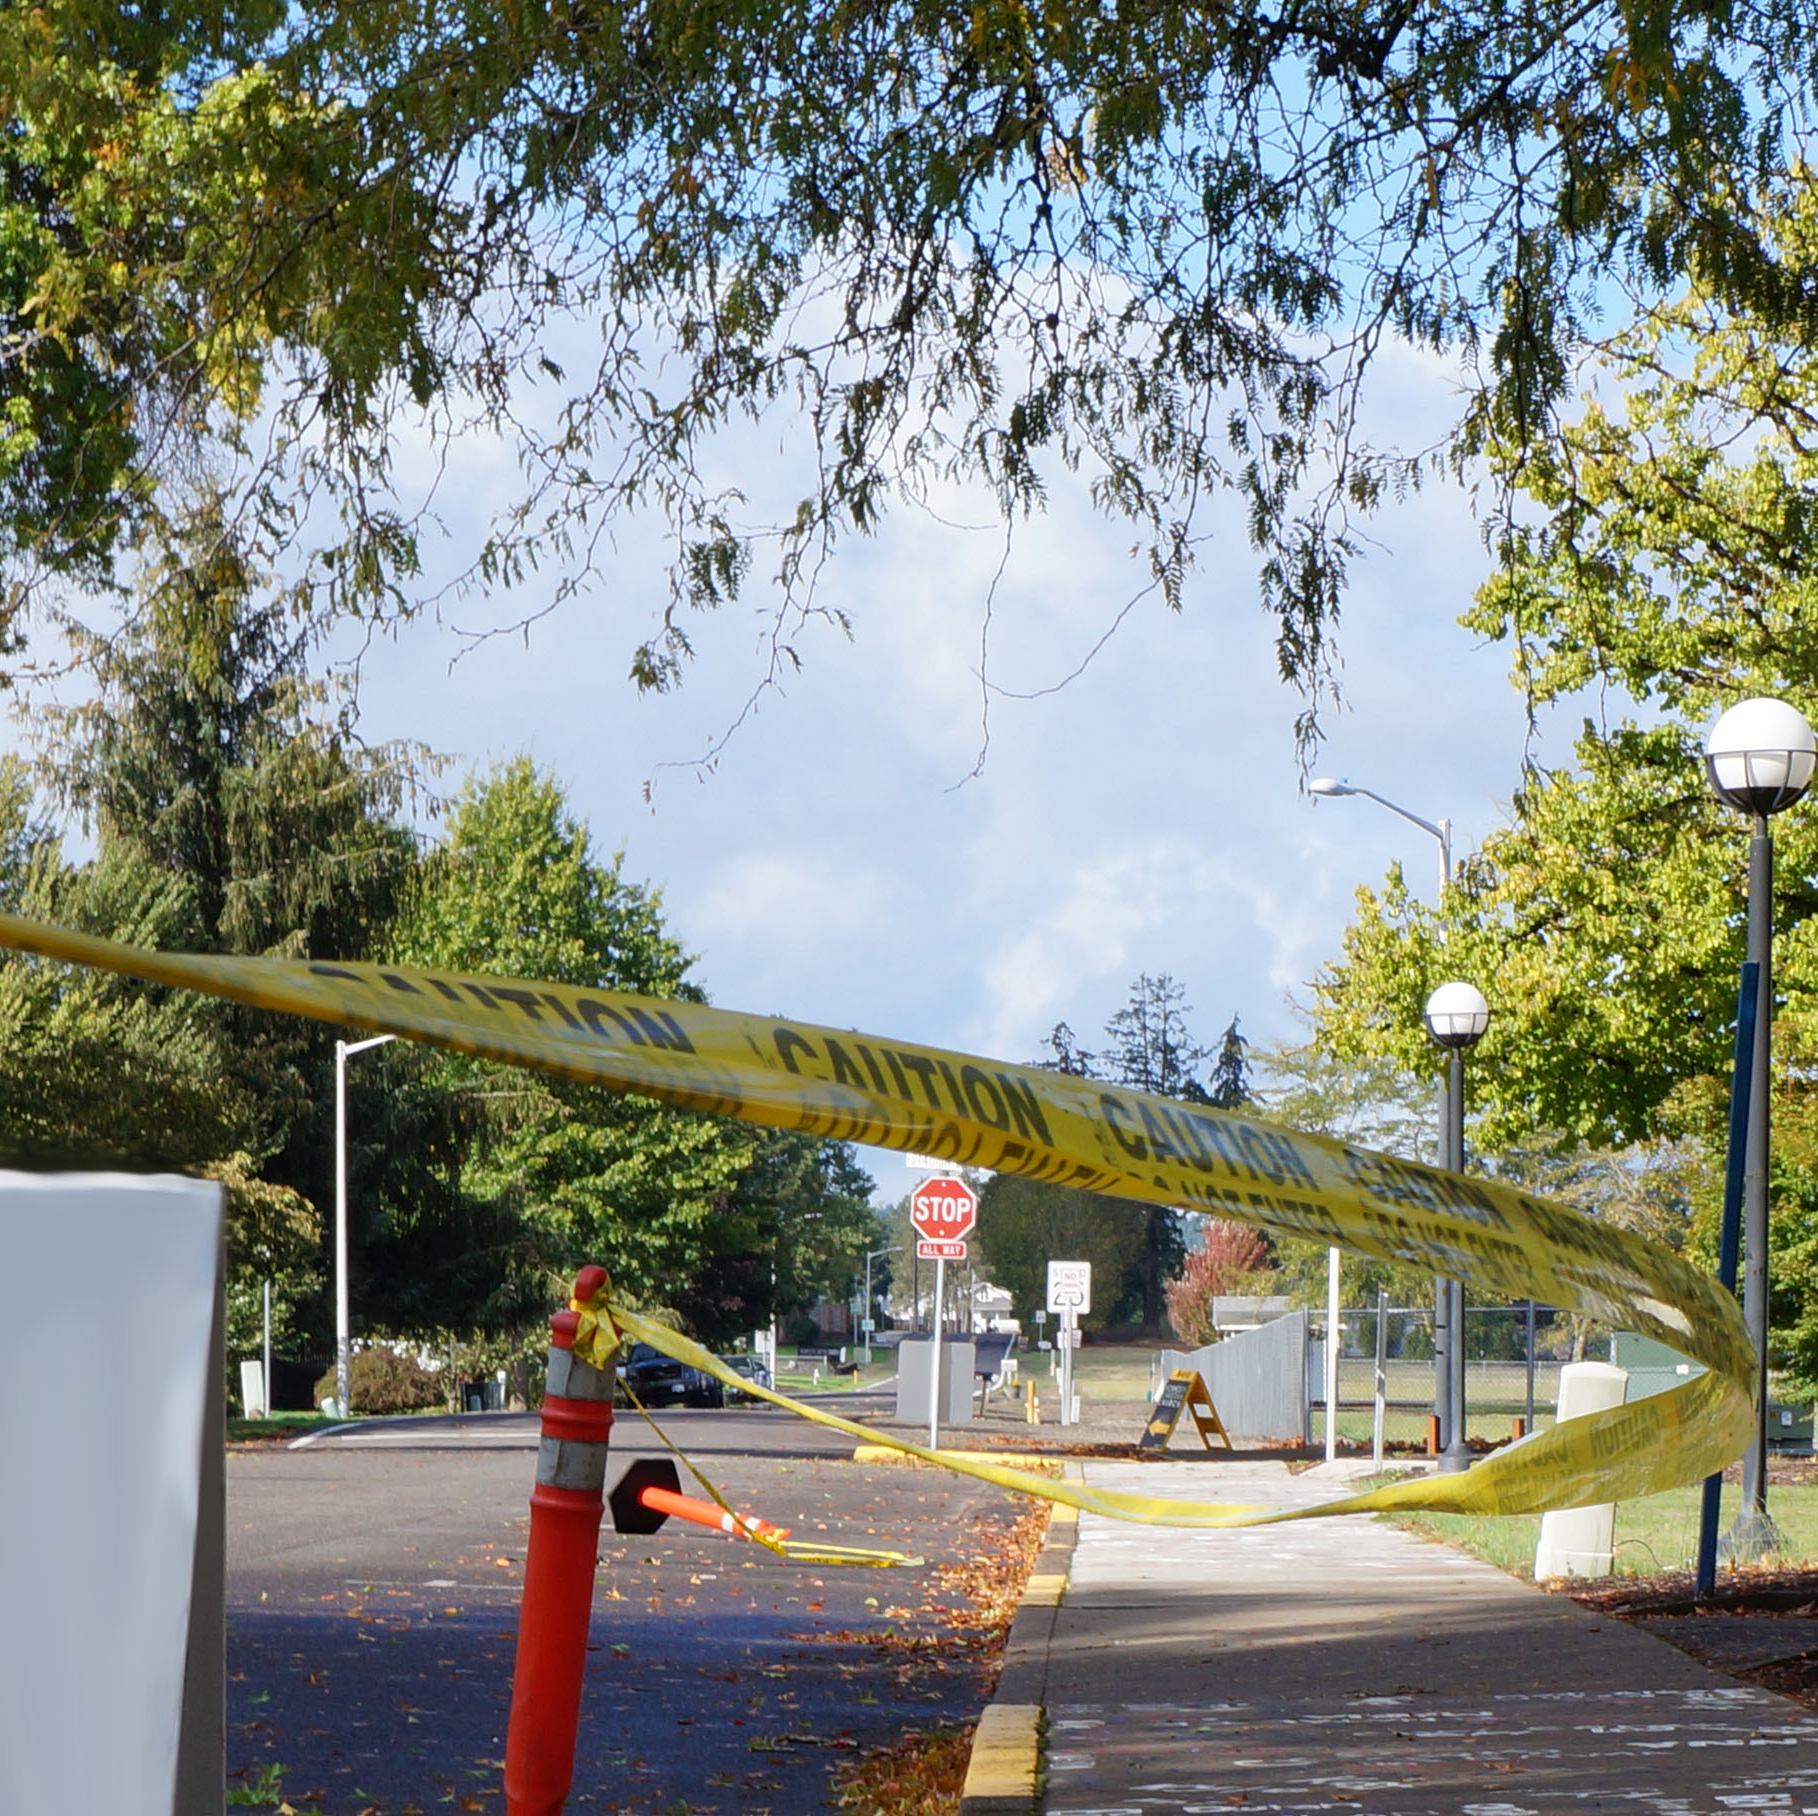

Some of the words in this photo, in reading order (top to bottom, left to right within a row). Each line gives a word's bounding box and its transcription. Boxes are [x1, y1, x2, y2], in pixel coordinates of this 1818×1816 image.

[773, 1027, 1053, 1148] CAUTION
[1096, 1092, 1321, 1193] CAUTION
[916, 1196, 972, 1222] STOP
[921, 1244, 942, 1256] ALL
[943, 1244, 962, 1256] WAY
